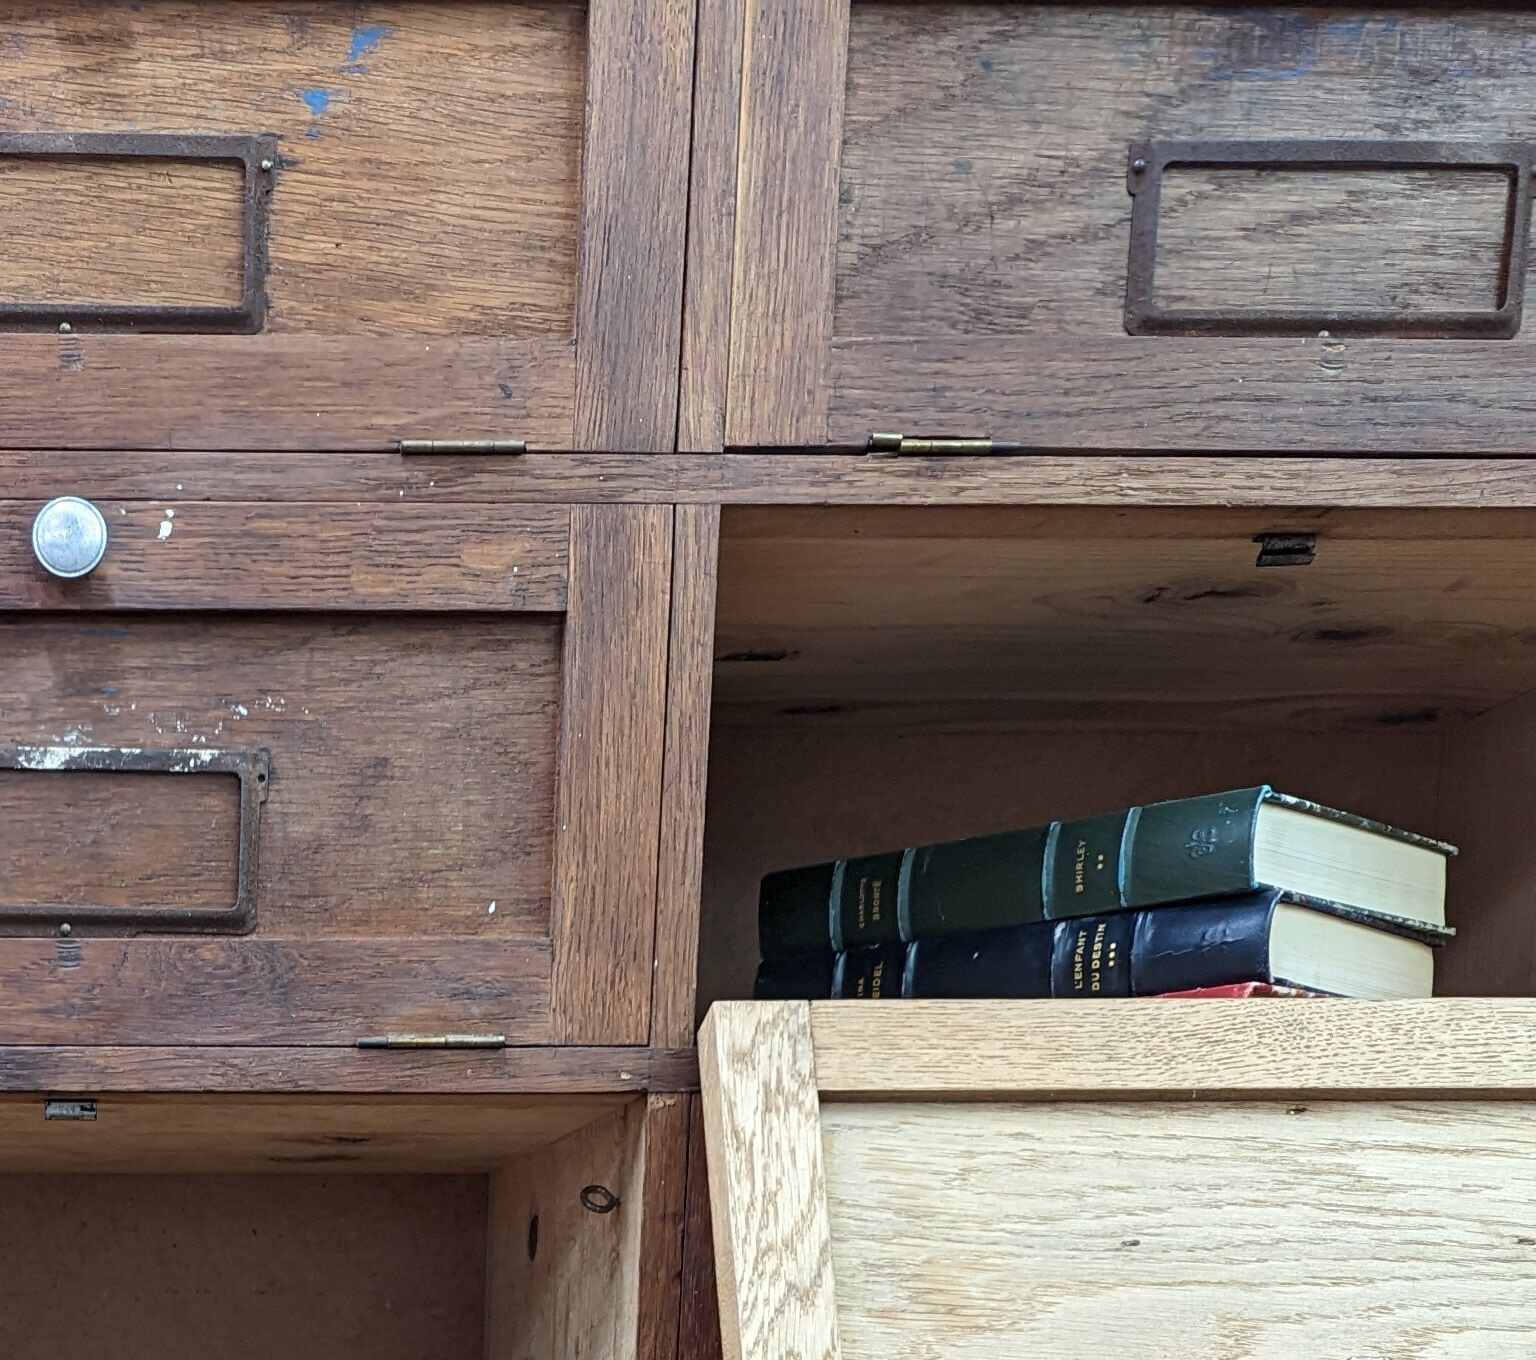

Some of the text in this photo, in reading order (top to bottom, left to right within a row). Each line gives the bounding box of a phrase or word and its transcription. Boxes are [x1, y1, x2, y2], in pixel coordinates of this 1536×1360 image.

[1075, 839, 1087, 893] SHIRLEY
[871, 960, 884, 999] EIDEL
[1074, 930, 1087, 990] L'ENFANT
[1091, 923, 1107, 991] DU DESTIN
